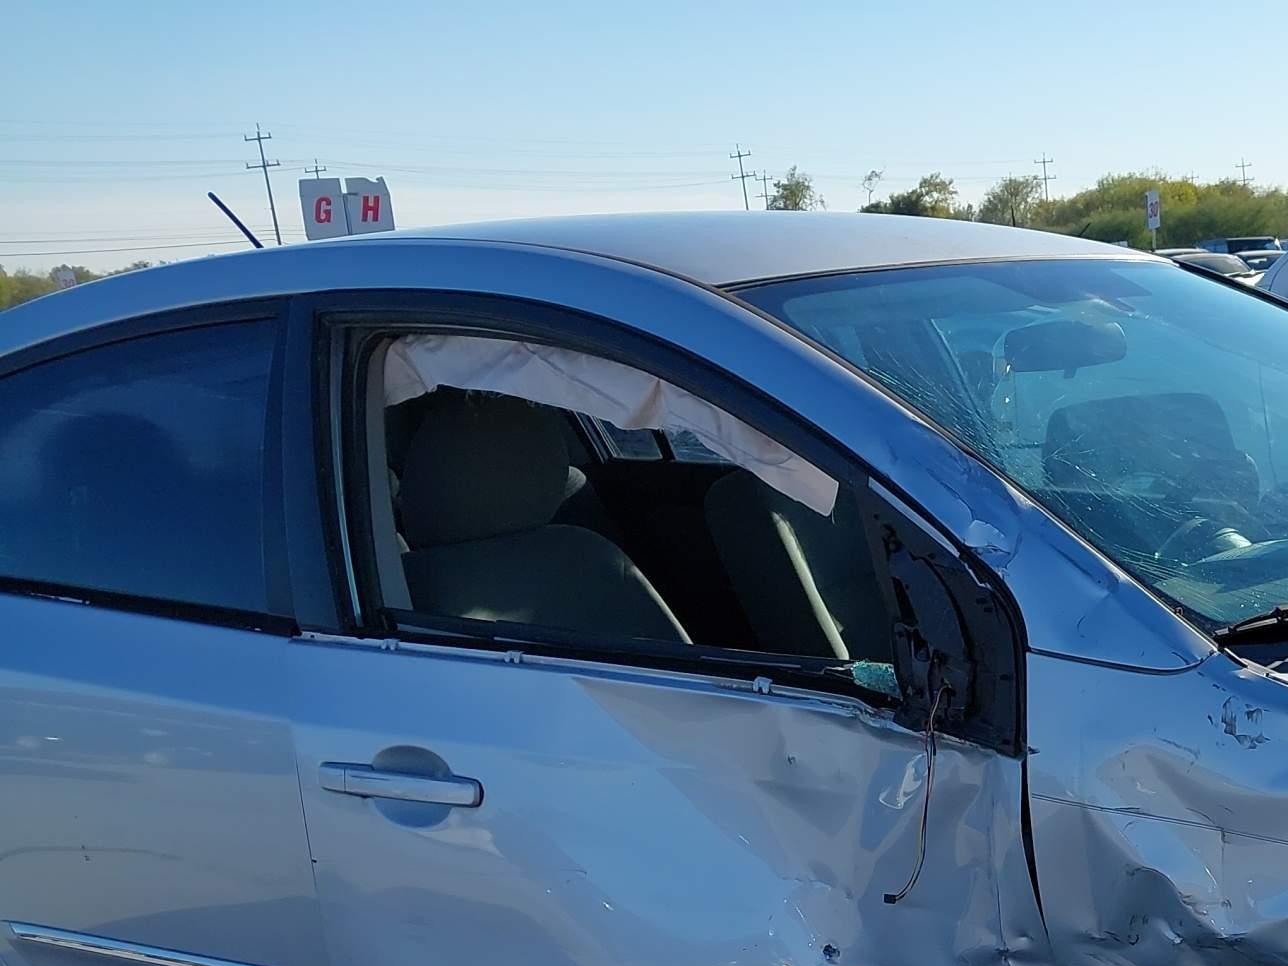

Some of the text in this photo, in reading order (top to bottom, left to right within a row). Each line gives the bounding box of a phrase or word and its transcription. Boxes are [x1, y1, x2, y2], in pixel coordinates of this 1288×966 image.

[314, 196, 332, 224] G
[361, 195, 380, 222] H
[1148, 200, 1160, 219] 30
